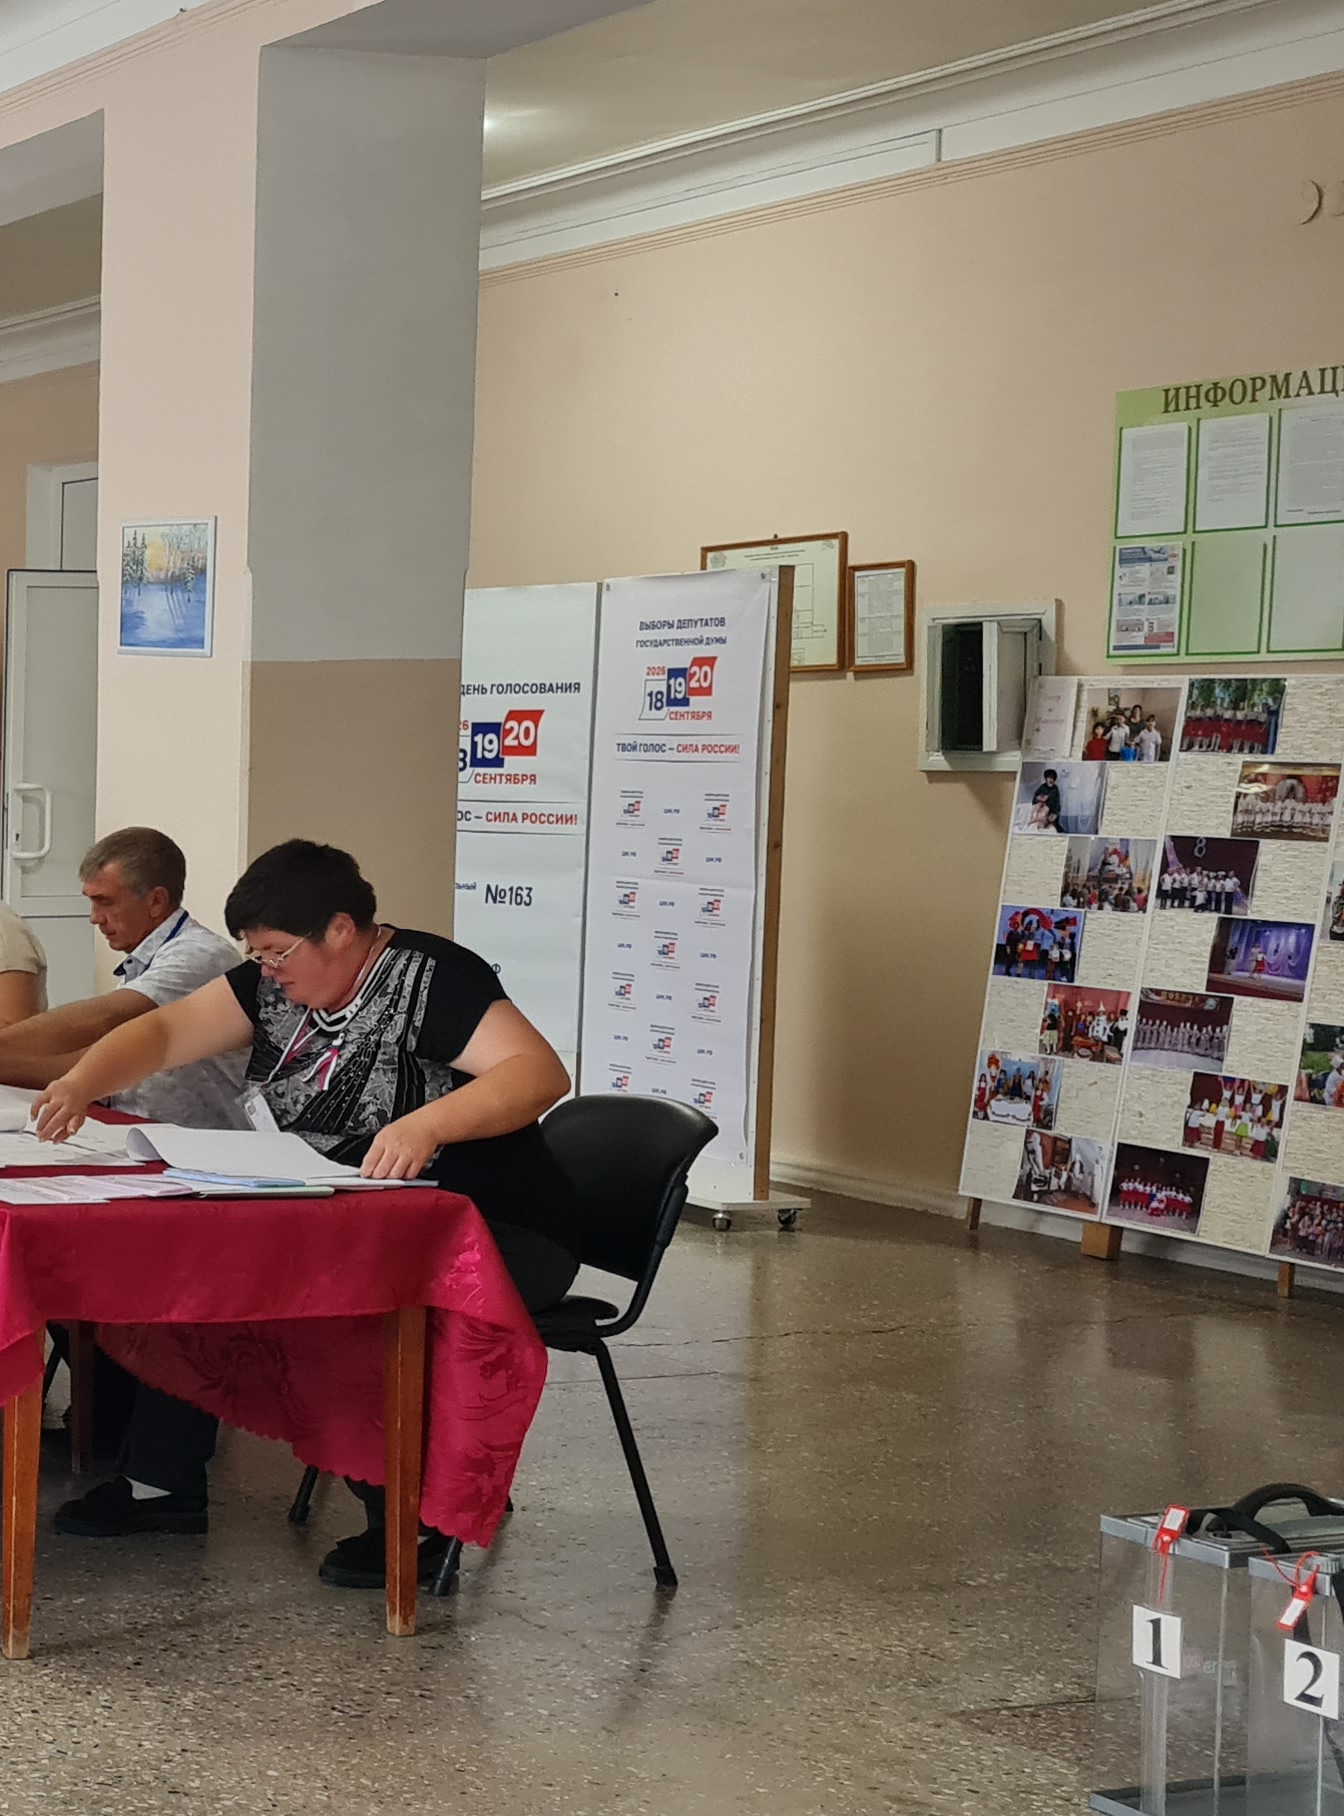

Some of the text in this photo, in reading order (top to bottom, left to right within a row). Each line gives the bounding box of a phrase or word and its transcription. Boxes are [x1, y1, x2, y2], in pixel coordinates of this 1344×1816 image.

[1162, 364, 1344, 414] ИНФОРМАЦ
[639, 617, 726, 631] ВЫБОРЫ ДЕПУТАТОВ
[636, 635, 727, 648] ГОСУДАРСТВЕННОЙ ДУМЫ
[689, 665, 712, 688] 20
[490, 682, 581, 695] ГОЛОСОВАНИЯ
[669, 677, 686, 700] 19
[647, 690, 664, 711] 18
[669, 711, 712, 721] СЕНТЯБРЯ
[504, 720, 536, 747] 20
[474, 733, 499, 760] 19
[616, 741, 637, 753] ТВОЙ
[639, 744, 667, 753] ГОЛОС
[676, 744, 700, 753] СИЛА
[701, 744, 740, 755] РОССИИ!
[474, 772, 537, 785] СЕНТЯБРЯ
[486, 811, 518, 824] СИЛА
[520, 812, 578, 825] РОССИИ!
[484, 884, 533, 907] №163
[1145, 1617, 1169, 1670] 1
[1294, 1650, 1325, 1708] 2
